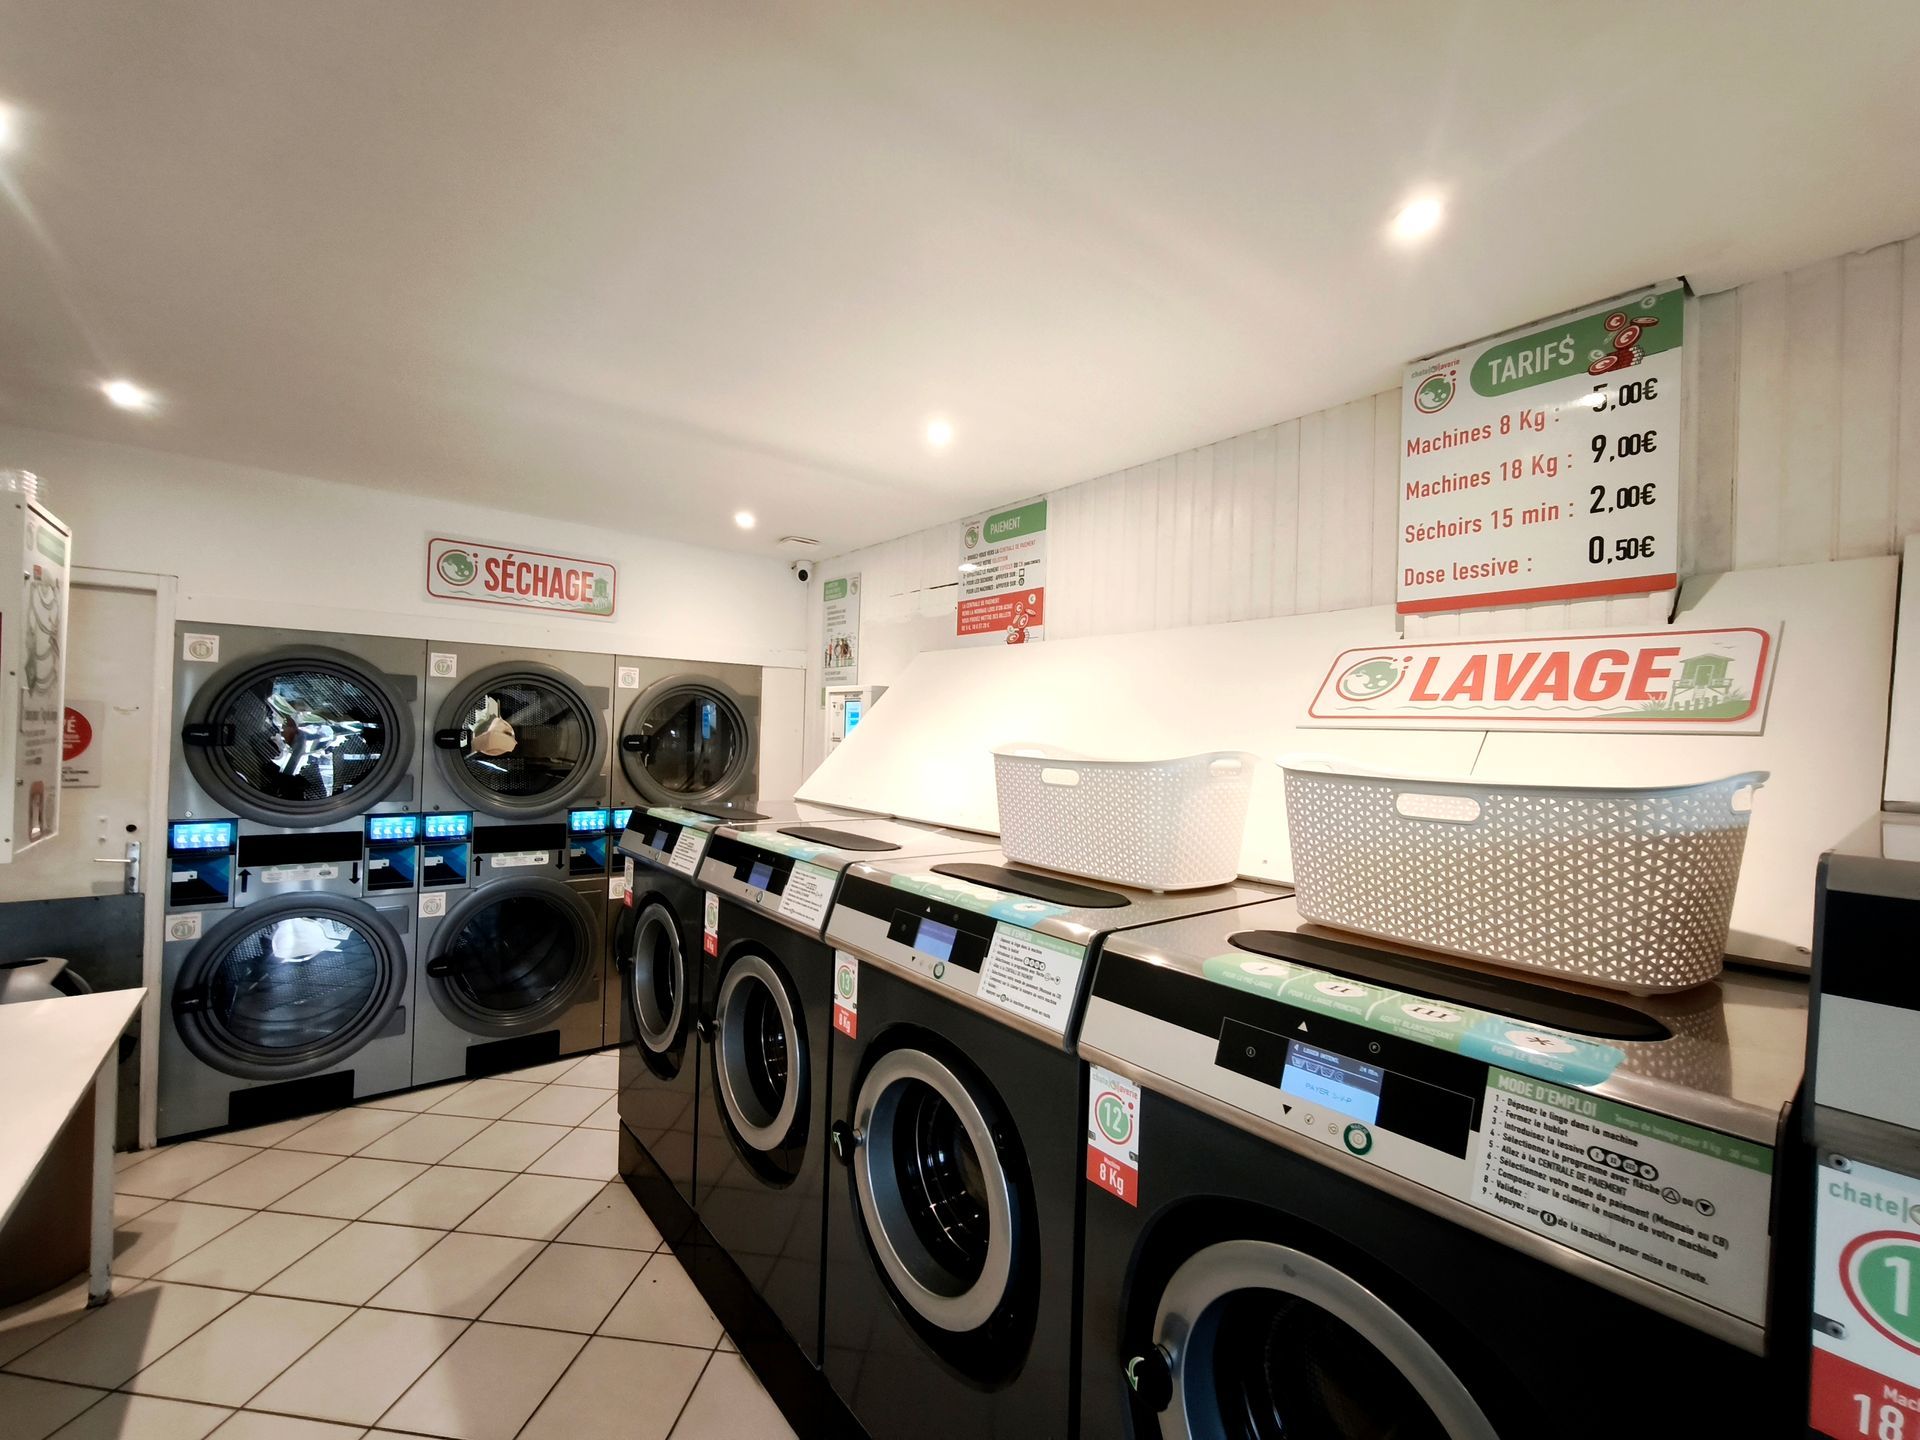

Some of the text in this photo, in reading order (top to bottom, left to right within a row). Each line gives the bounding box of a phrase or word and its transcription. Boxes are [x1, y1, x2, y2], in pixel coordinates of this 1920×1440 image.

[1407, 377, 1658, 457] Machines 8 Kg 5,00€
[1406, 430, 1657, 500] Machines 18 Kg 9,00€
[990, 516, 1020, 535] PAIEMENT
[1405, 483, 1656, 543] Séchoirs 15 min 2,00€
[484, 553, 594, 603] SÉCHAGE
[1404, 535, 1655, 587] Dose lessive 0,50€
[1408, 646, 1681, 702] LAVAGE
[842, 972, 850, 991] 13
[1491, 1045, 1514, 1057] POUR
[1516, 1051, 1526, 1061] LE
[1305, 1082, 1329, 1096] PAYER
[1498, 1075, 1598, 1117] MODE D'EMPLOI
[1104, 1102, 1122, 1133] 12
[1492, 1117, 1585, 1155] 3 Introduisez la lessive
[1493, 1105, 1568, 1137] 2 Fermez le hublot
[1495, 1094, 1639, 1147] 1 Déposez le linge dans la machine
[1099, 1162, 1124, 1196] 8 Kg
[1484, 1175, 1522, 1197] 8 Validez
[1489, 1140, 1627, 1196] 5 Allez à la CENTRALE DE PAIEMENT
[1490, 1128, 1693, 1207] 4 Sélectionnez le programme avec flèche ou
[1485, 1163, 1718, 1259] 7 Composez sur le clavier le numéro de votre machine
[1487, 1151, 1729, 1250] 6 Sélectionnez votre mode de paiement (Monnaie ou CB)
[1482, 1187, 1708, 1285] 9 Appuyez sur de la machine pour mise en route.
[1853, 1394, 1905, 1440] 18
